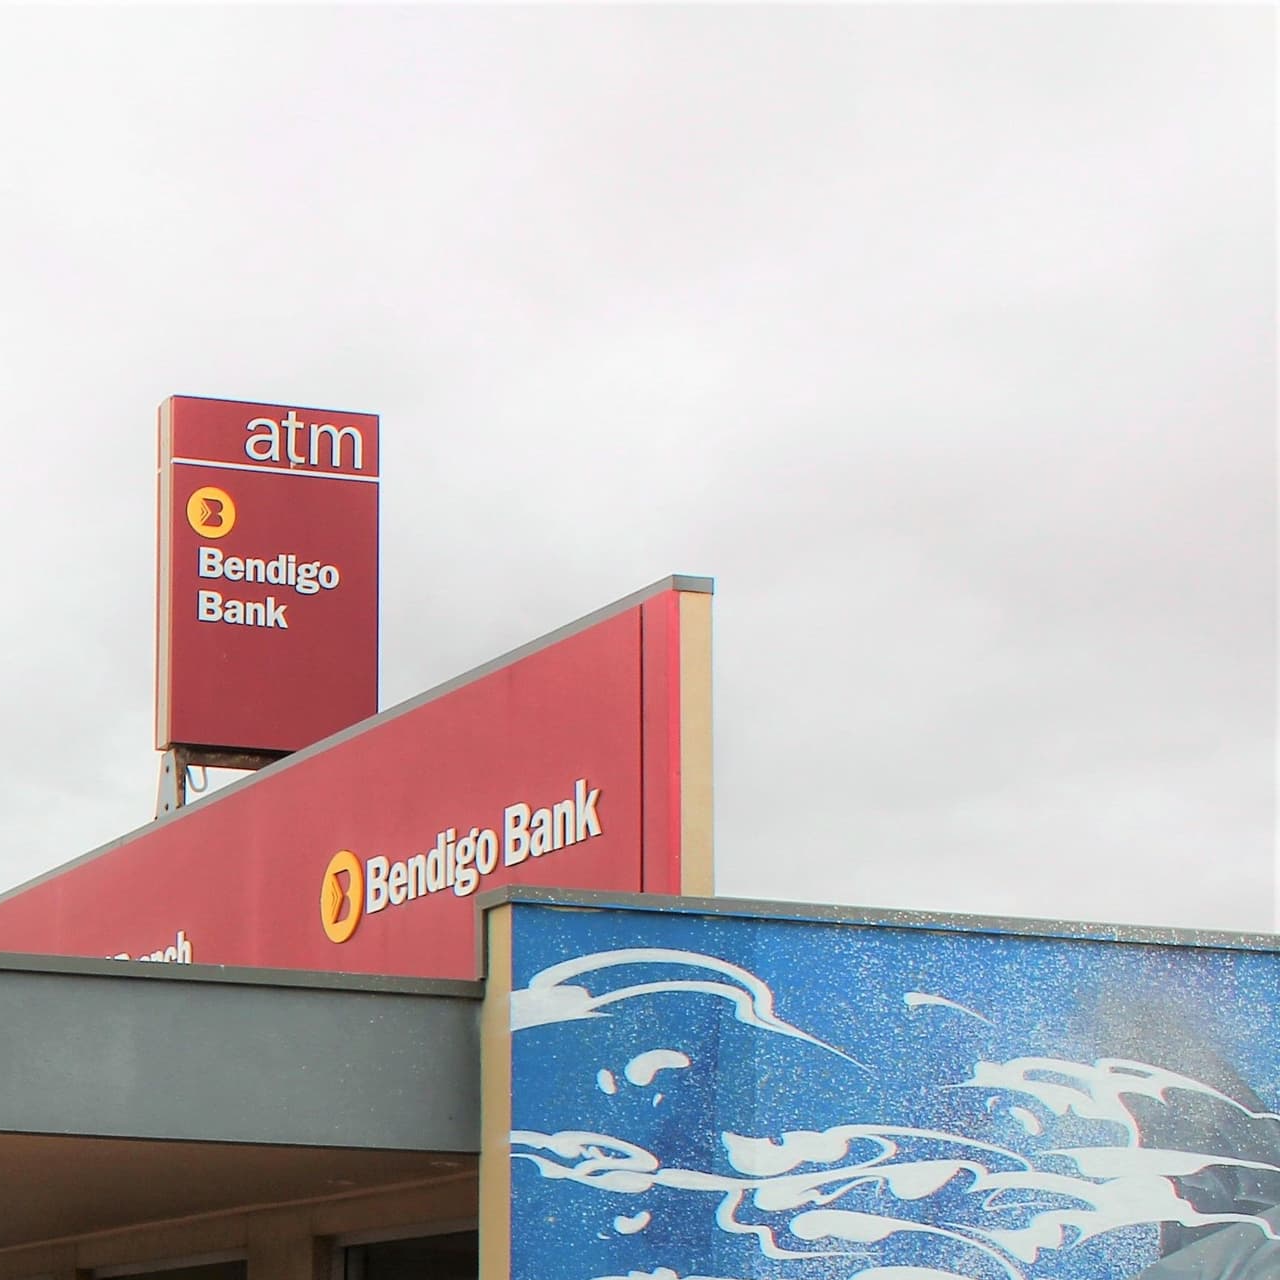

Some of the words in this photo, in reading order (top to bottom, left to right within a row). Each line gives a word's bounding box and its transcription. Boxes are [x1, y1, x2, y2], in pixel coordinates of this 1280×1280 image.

[244, 411, 363, 469] atm
[197, 546, 340, 595] Bendigo
[197, 590, 289, 629] Bank
[365, 825, 498, 915] Bendigo
[503, 777, 603, 867] Bank
